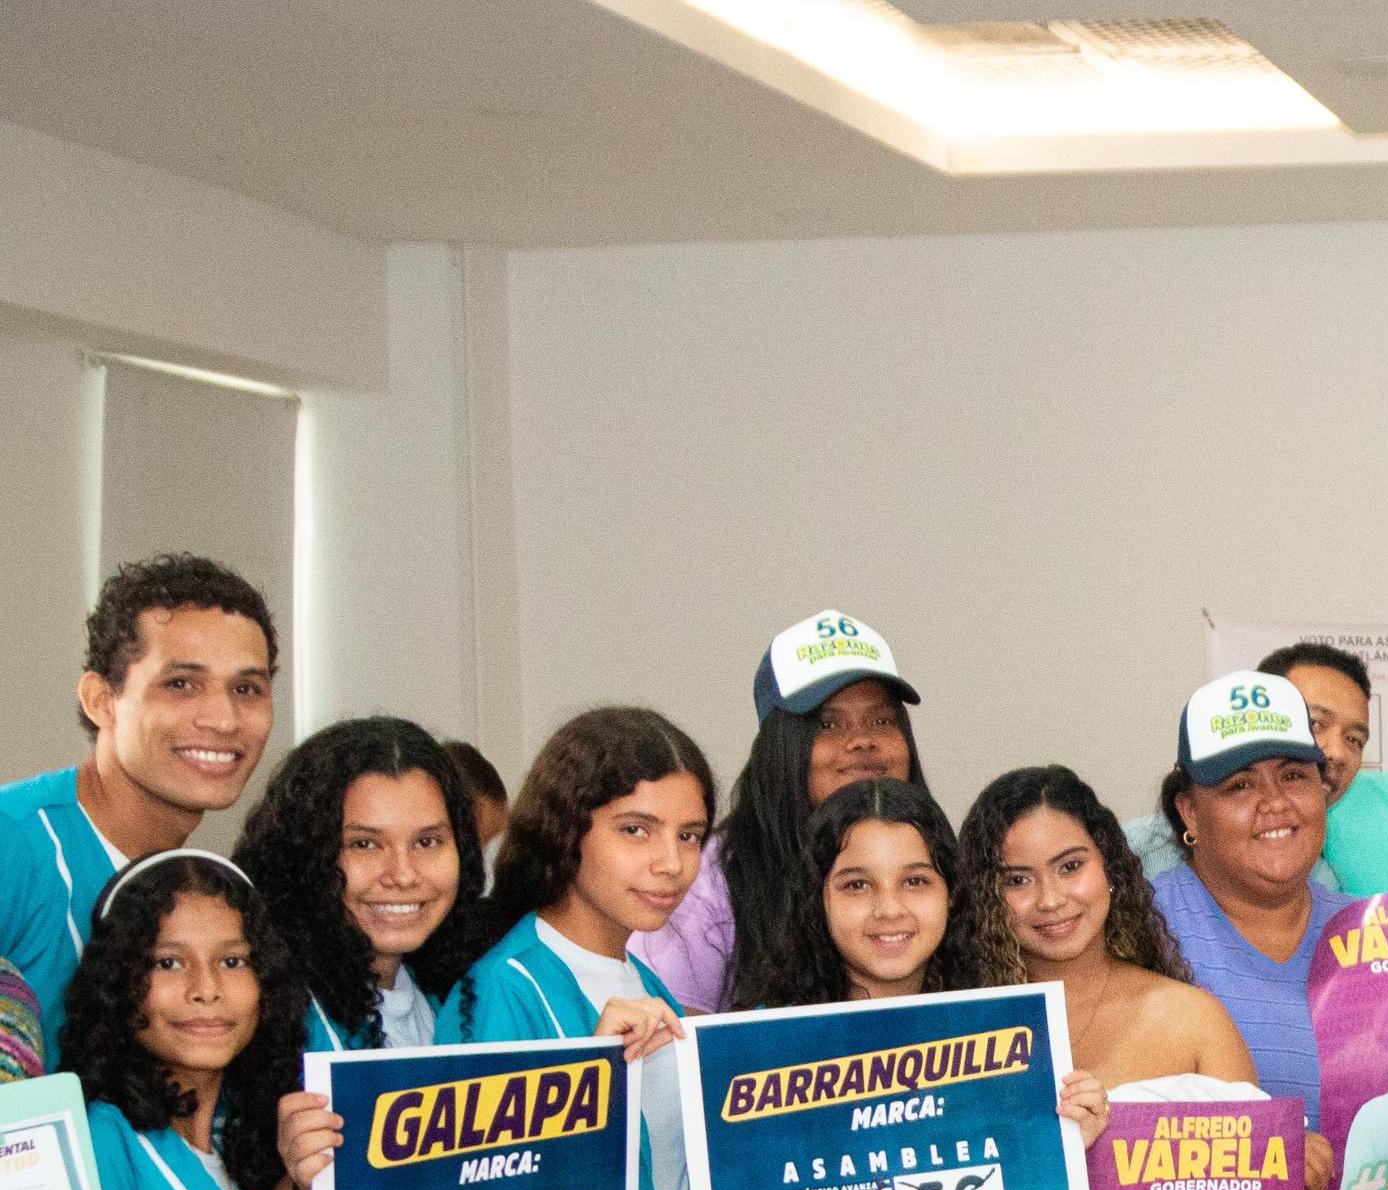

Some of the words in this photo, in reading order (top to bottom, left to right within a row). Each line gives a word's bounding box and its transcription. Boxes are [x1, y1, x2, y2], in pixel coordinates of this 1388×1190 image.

[816, 617, 859, 639] 56
[1338, 636, 1373, 647] PARA
[1230, 685, 1270, 711] 56
[728, 1031, 1030, 1117] BARRANQUILLA
[381, 1066, 599, 1161] GALAPA
[852, 1095, 944, 1131] MARCA:
[1154, 1115, 1251, 1139] ALFREDO
[459, 1151, 541, 1185] MARCA:
[783, 1137, 999, 1184] ASAMBLEA
[1112, 1136, 1289, 1186] VARELA
